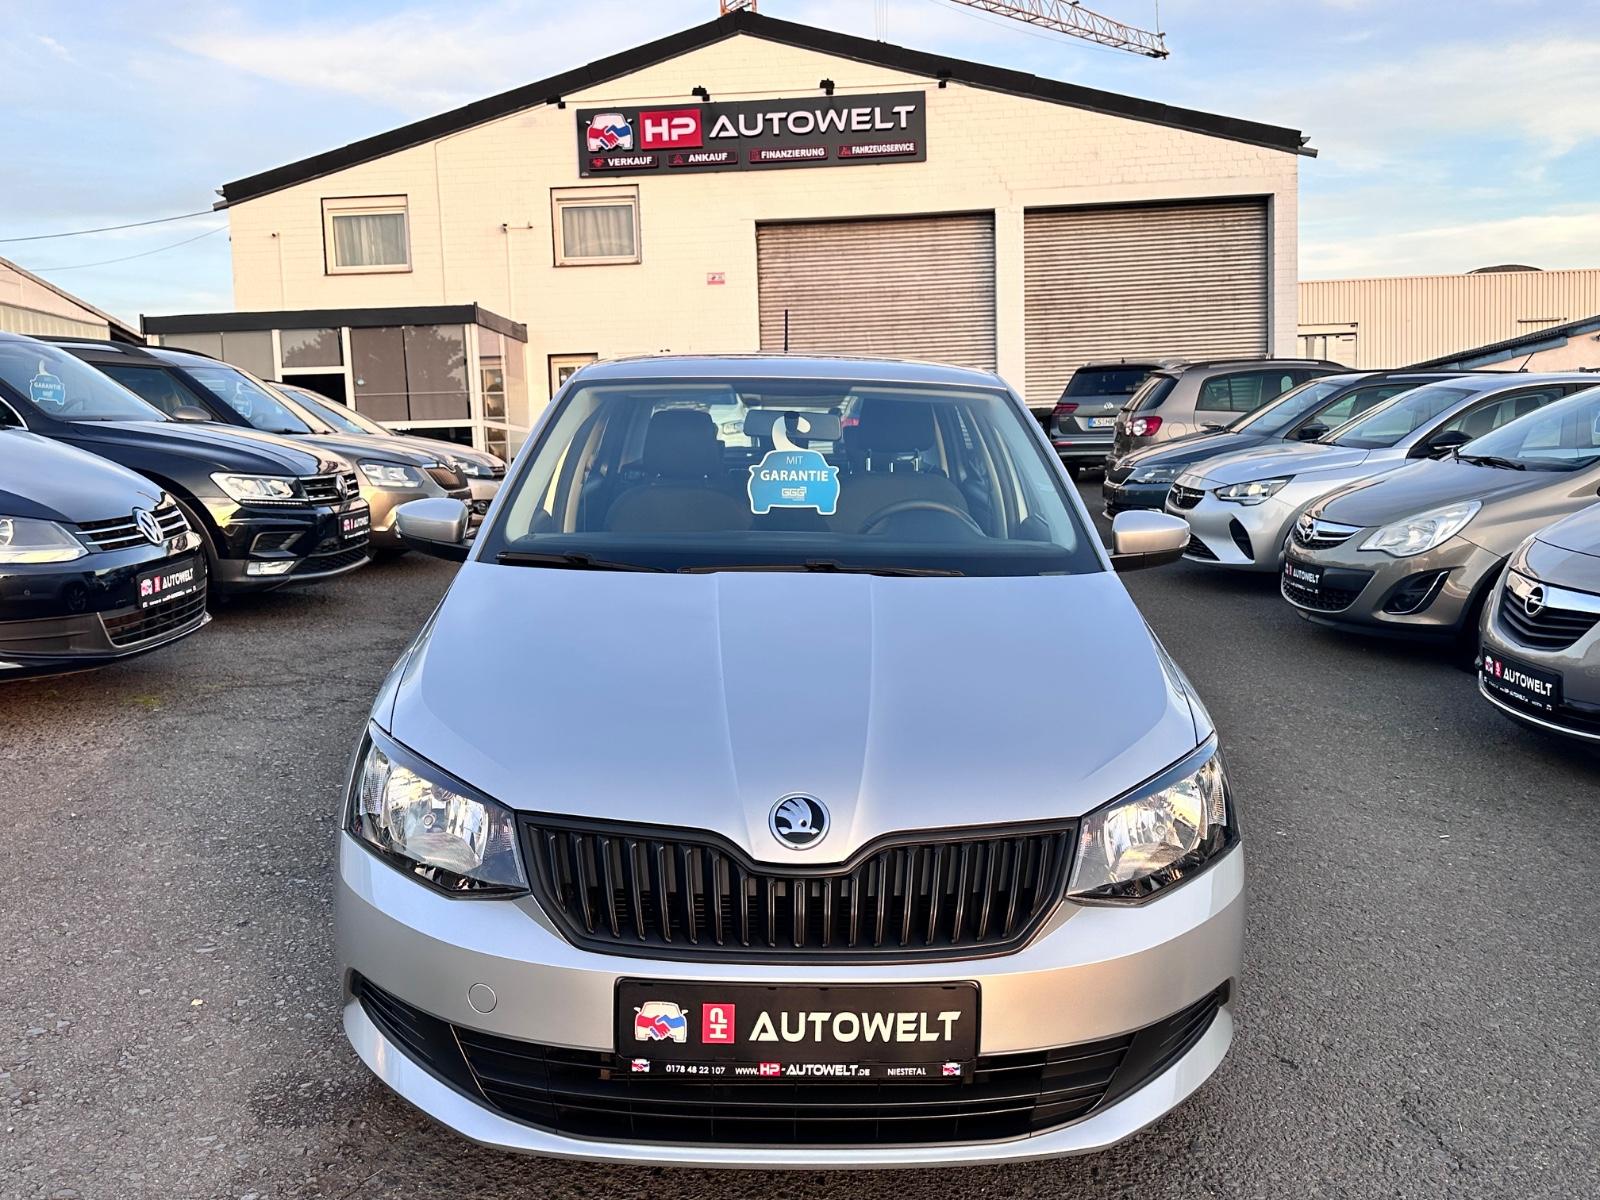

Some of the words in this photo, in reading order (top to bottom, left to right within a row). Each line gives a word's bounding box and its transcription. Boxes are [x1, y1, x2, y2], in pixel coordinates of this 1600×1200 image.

[645, 120, 697, 142] HP
[709, 105, 916, 139] AUTOWELT
[761, 148, 825, 159] FINANZIERUNG
[851, 143, 915, 154] FAHRZEUGSERVICE
[607, 157, 653, 167] VERKAUF
[688, 153, 728, 163] ANKAUF
[786, 456, 803, 464] MIT
[760, 470, 829, 481] GARANTIE
[162, 567, 194, 590] AUTOWELT
[1503, 667, 1553, 696] AUTOWELT
[748, 1010, 961, 1043] AUTOWELT
[665, 1064, 686, 1073] 0178
[687, 1064, 698, 1074] 48
[698, 1065, 709, 1074] 22
[711, 1066, 726, 1075] 107
[887, 1067, 927, 1076] NIESTETAL
